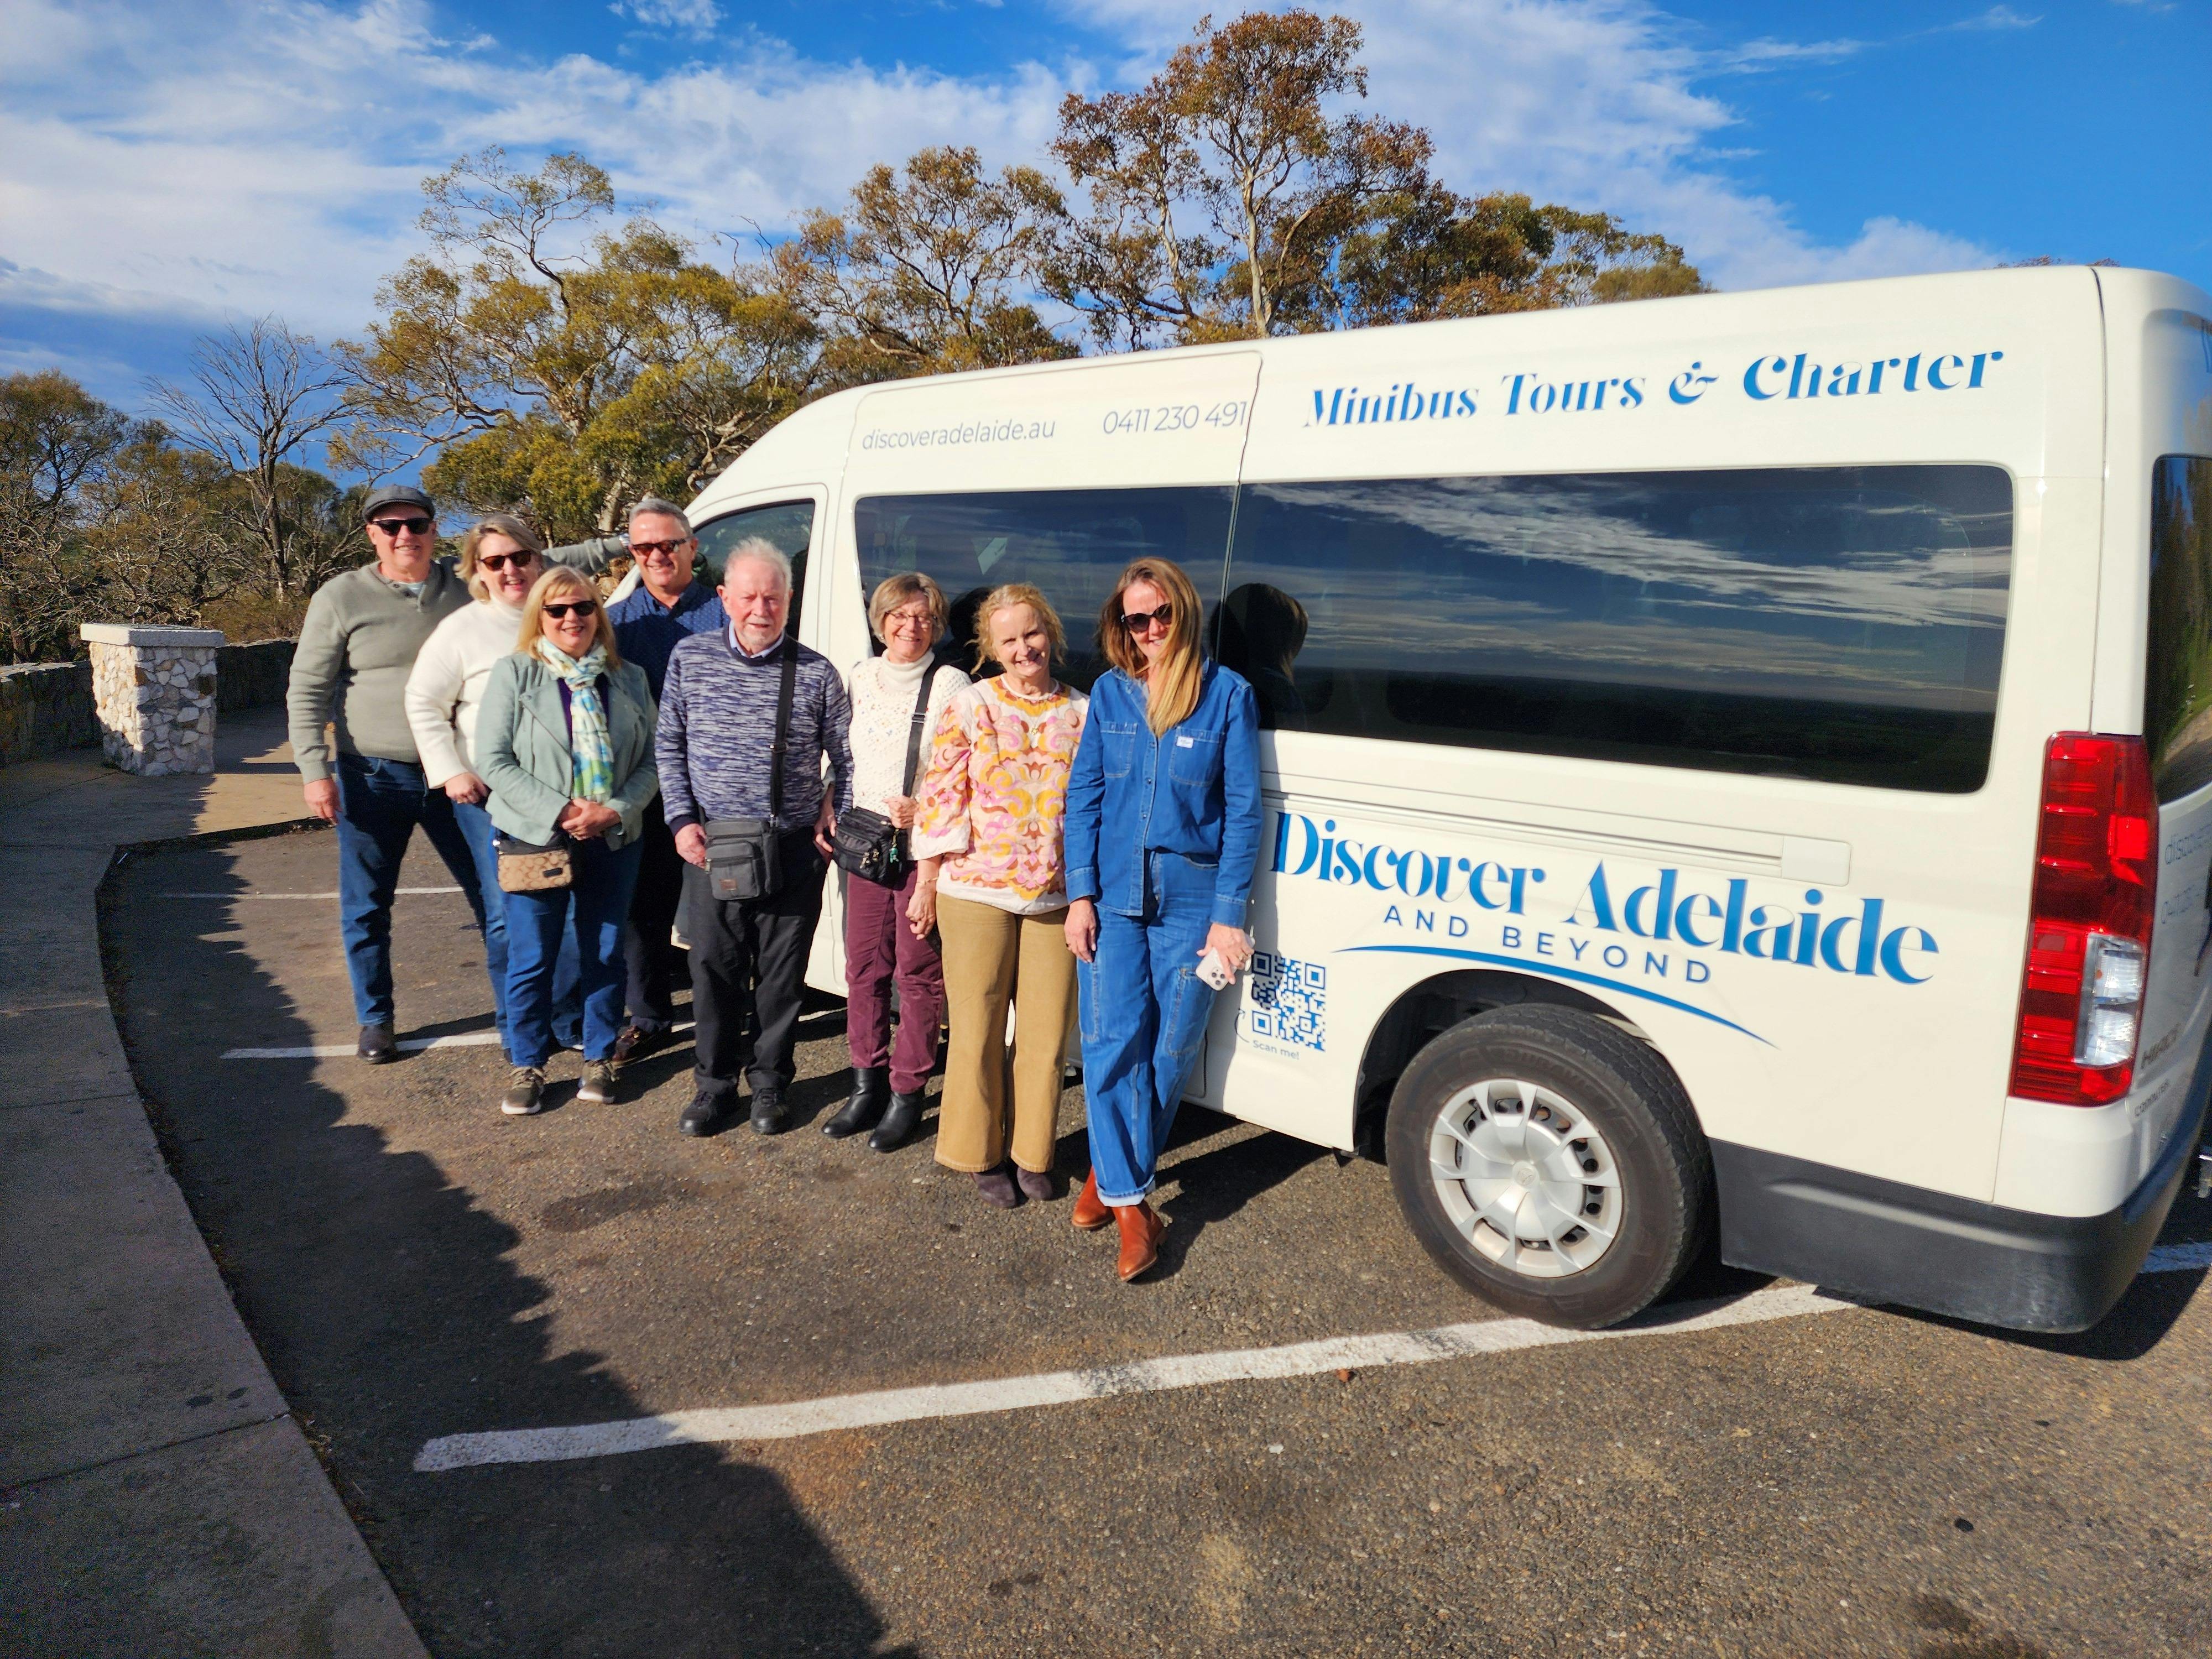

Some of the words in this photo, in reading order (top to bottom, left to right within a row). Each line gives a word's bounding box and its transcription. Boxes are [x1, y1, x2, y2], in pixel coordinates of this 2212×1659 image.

[1301, 382, 1480, 427] Minibus
[1501, 372, 1647, 416] Tours
[1668, 360, 1721, 406] &
[1742, 350, 2005, 403] Charter
[862, 418, 1056, 450] discoveradelaide.au
[1103, 408, 1151, 435] 0411
[1154, 405, 1200, 431] 230
[1204, 401, 1248, 427] 491
[1269, 811, 1547, 916] Discover
[1560, 859, 1940, 985] Adelaide
[1384, 905, 1469, 938] AND
[1502, 925, 1712, 984] BEYOND
[1253, 1040, 1277, 1053] Scan
[1280, 1049, 1300, 1060] me!
